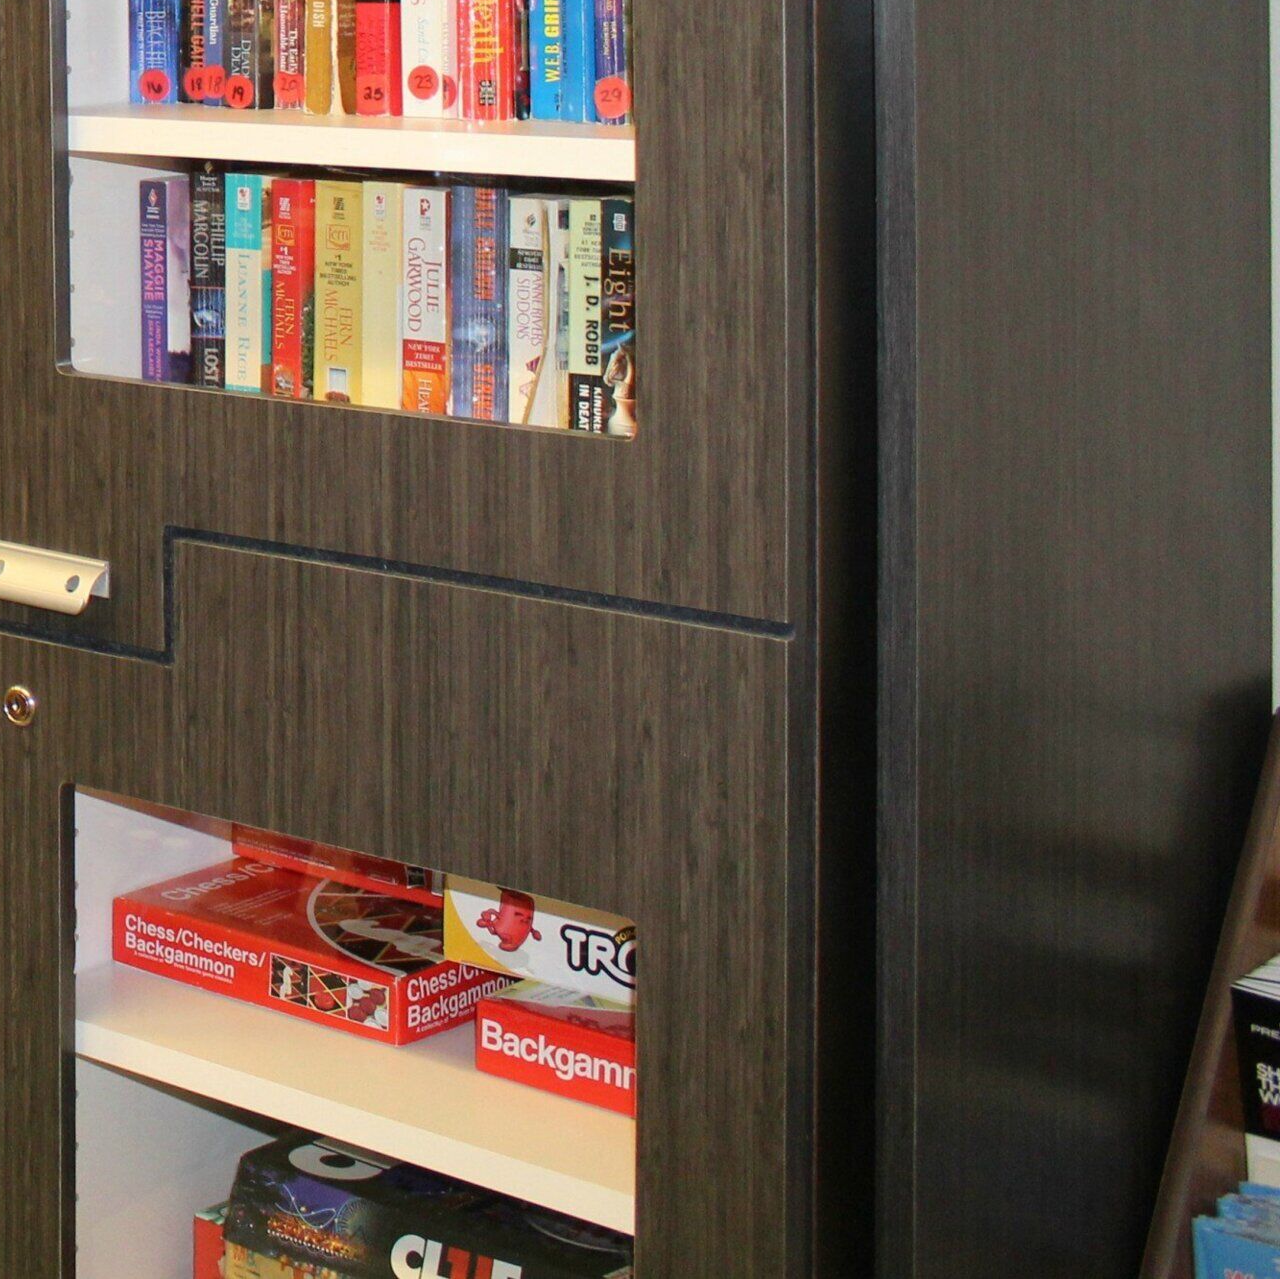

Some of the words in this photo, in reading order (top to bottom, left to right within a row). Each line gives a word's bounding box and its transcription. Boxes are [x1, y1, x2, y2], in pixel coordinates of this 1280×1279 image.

[288, 27, 298, 48] The
[313, 2, 326, 28] DISH
[544, 44, 562, 83] W.E.B.
[192, 199, 210, 279] MARGOLIN
[210, 212, 225, 267] PHILLIP
[143, 239, 154, 301] SHAYNE
[153, 239, 165, 301] MAGGIE
[406, 236, 426, 332] GARWOOD
[424, 259, 443, 314] JULIE
[583, 275, 600, 287] J.
[603, 246, 632, 333] Eight
[323, 288, 338, 361] MICHAELS
[338, 307, 353, 347] FERN
[515, 277, 530, 340] SIDDONS
[585, 294, 599, 312] D.
[203, 347, 219, 382] LOST
[584, 319, 598, 366] ROBB
[578, 400, 589, 431] DEAT
[579, 384, 589, 398] IN
[125, 913, 267, 968] Chess/Checkers/
[125, 931, 235, 979] Backgammon
[560, 924, 637, 989] TRO
